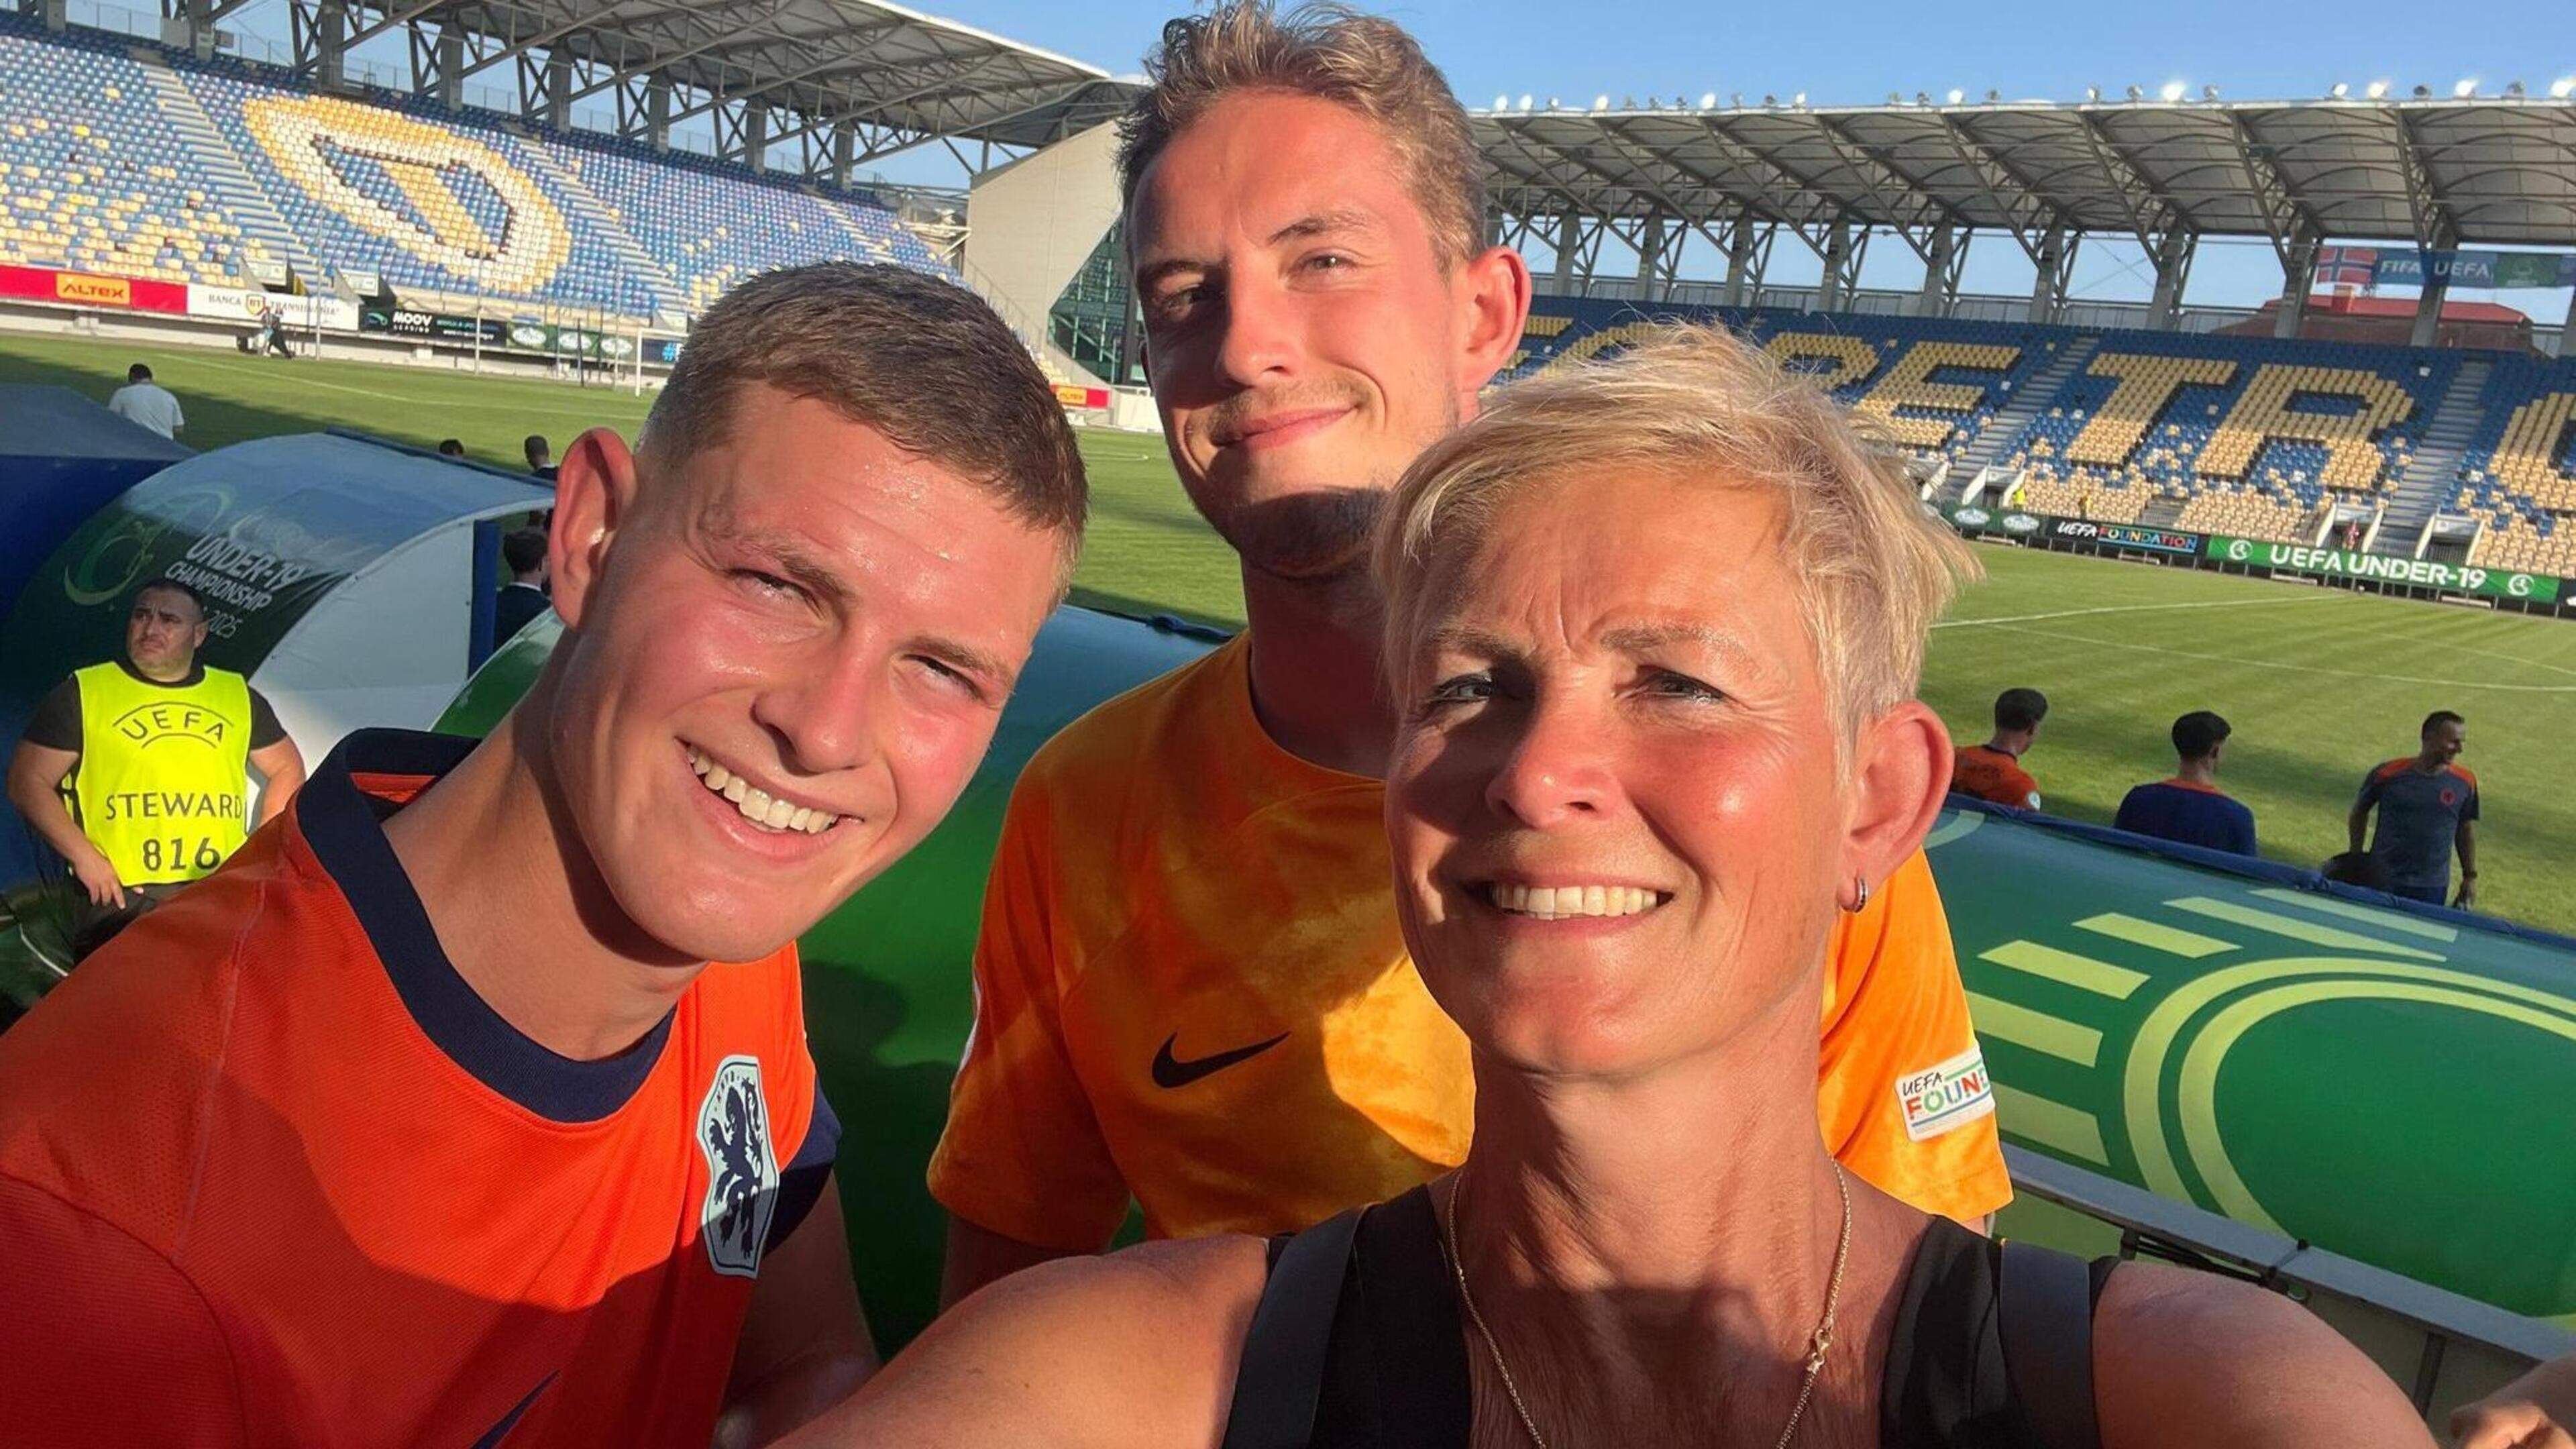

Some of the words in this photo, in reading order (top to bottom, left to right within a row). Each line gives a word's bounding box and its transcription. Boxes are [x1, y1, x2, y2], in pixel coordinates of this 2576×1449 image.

[2381, 260, 2422, 274] FIFA
[2434, 262, 2490, 278] UEFA
[208, 294, 242, 306] BANCA
[392, 311, 433, 327] MOOV
[2057, 521, 2098, 537] UEFA
[2098, 526, 2198, 550] FOUNDATION
[186, 533, 305, 592] UNDER-19
[2270, 544, 2342, 572] UEFA
[2349, 552, 2487, 589] UNDER-19
[164, 561, 272, 612] CHAMPIONSHIP
[209, 609, 244, 638] 2025
[121, 709, 224, 741] UEFA
[105, 792, 242, 820] STEWARD
[142, 837, 221, 871] 816
[1902, 1071, 1943, 1096] UEFA
